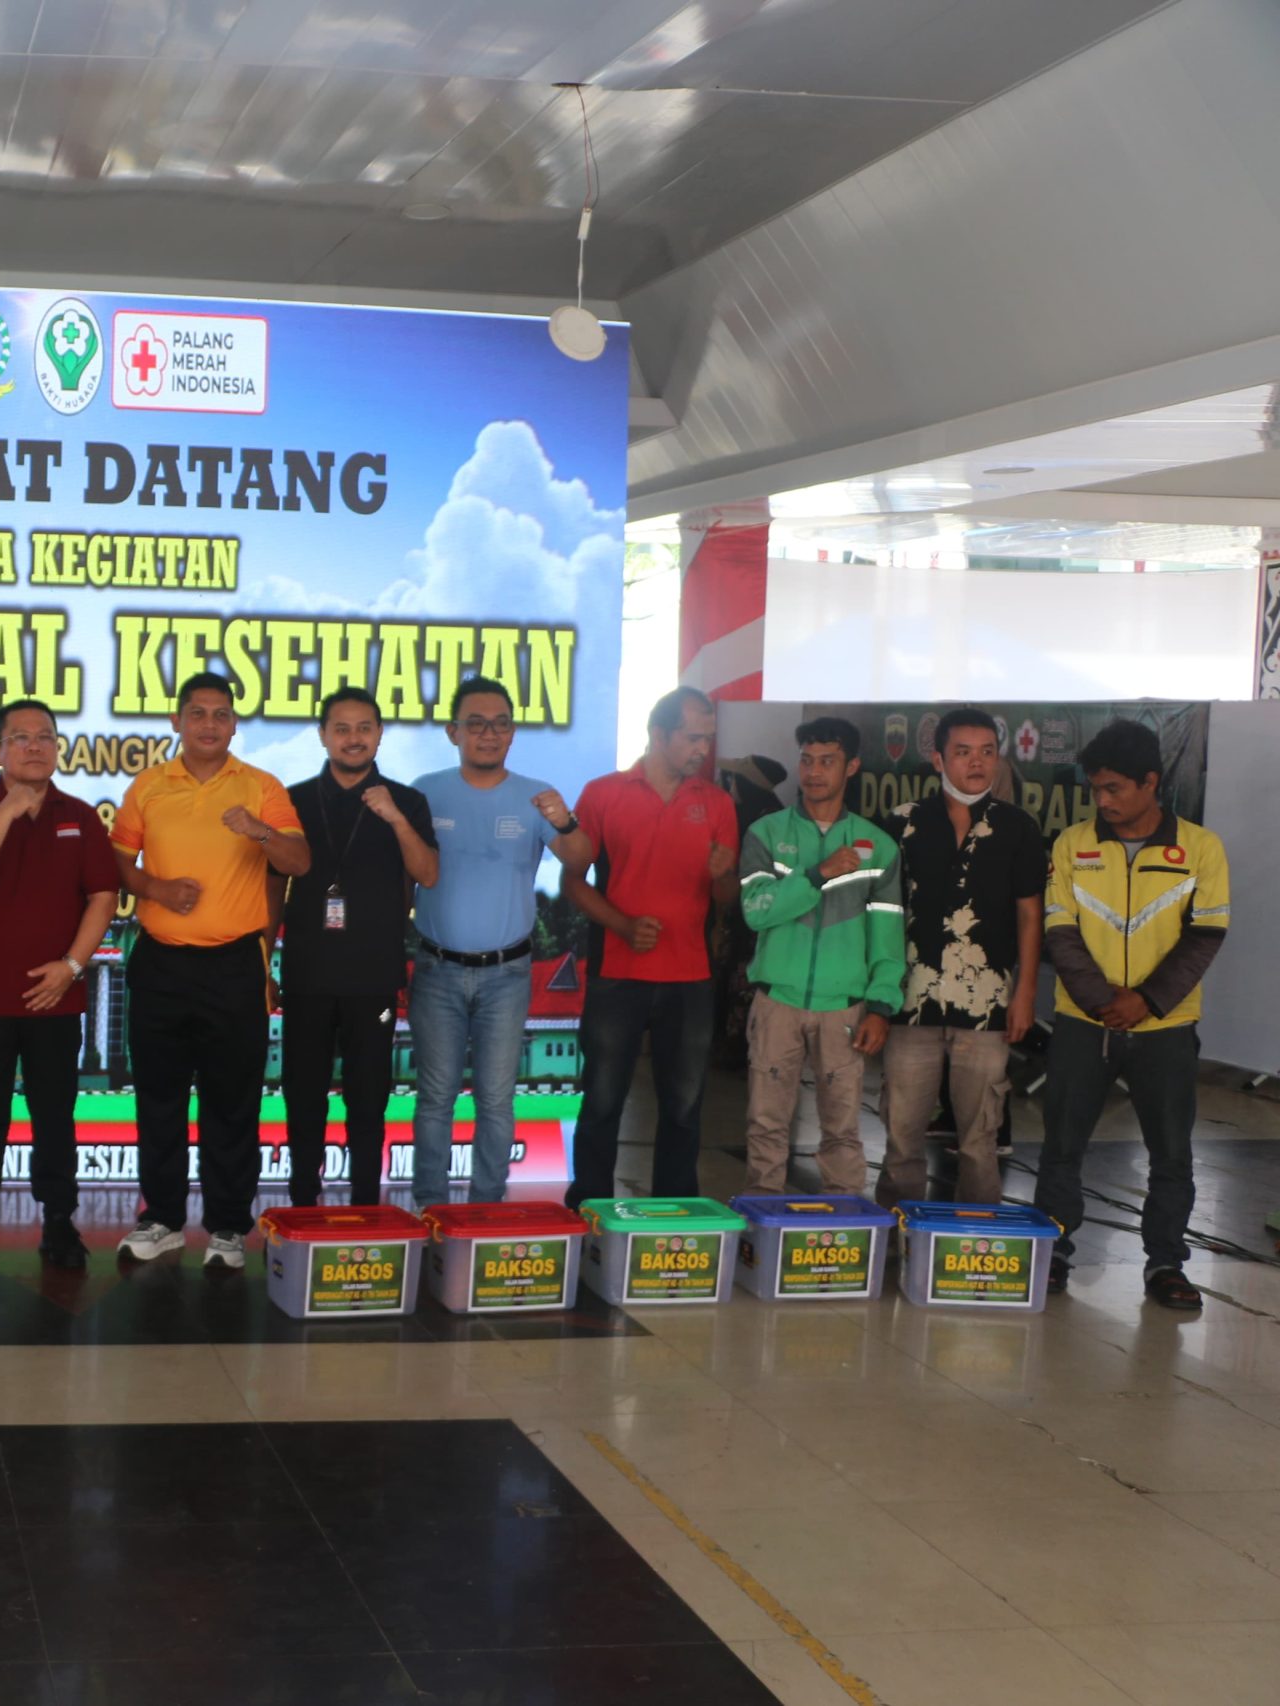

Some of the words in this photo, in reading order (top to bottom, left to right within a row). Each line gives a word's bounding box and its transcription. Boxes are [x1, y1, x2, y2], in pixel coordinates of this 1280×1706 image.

[172, 331, 234, 350] PALANG
[172, 353, 227, 372] MERAH
[40, 373, 62, 405] BAKTI
[172, 375, 256, 395] INDONESIA
[84, 441, 388, 515] DATANG
[30, 532, 238, 590] KEGIATAN
[113, 616, 576, 725] KESEHATAN
[640, 1252, 710, 1270] BAKSOS
[791, 1247, 861, 1266] BAKSOS
[944, 1254, 1020, 1273] BAKSOS
[322, 1262, 394, 1282] BAKSOS
[484, 1258, 556, 1278] BAKSOS
